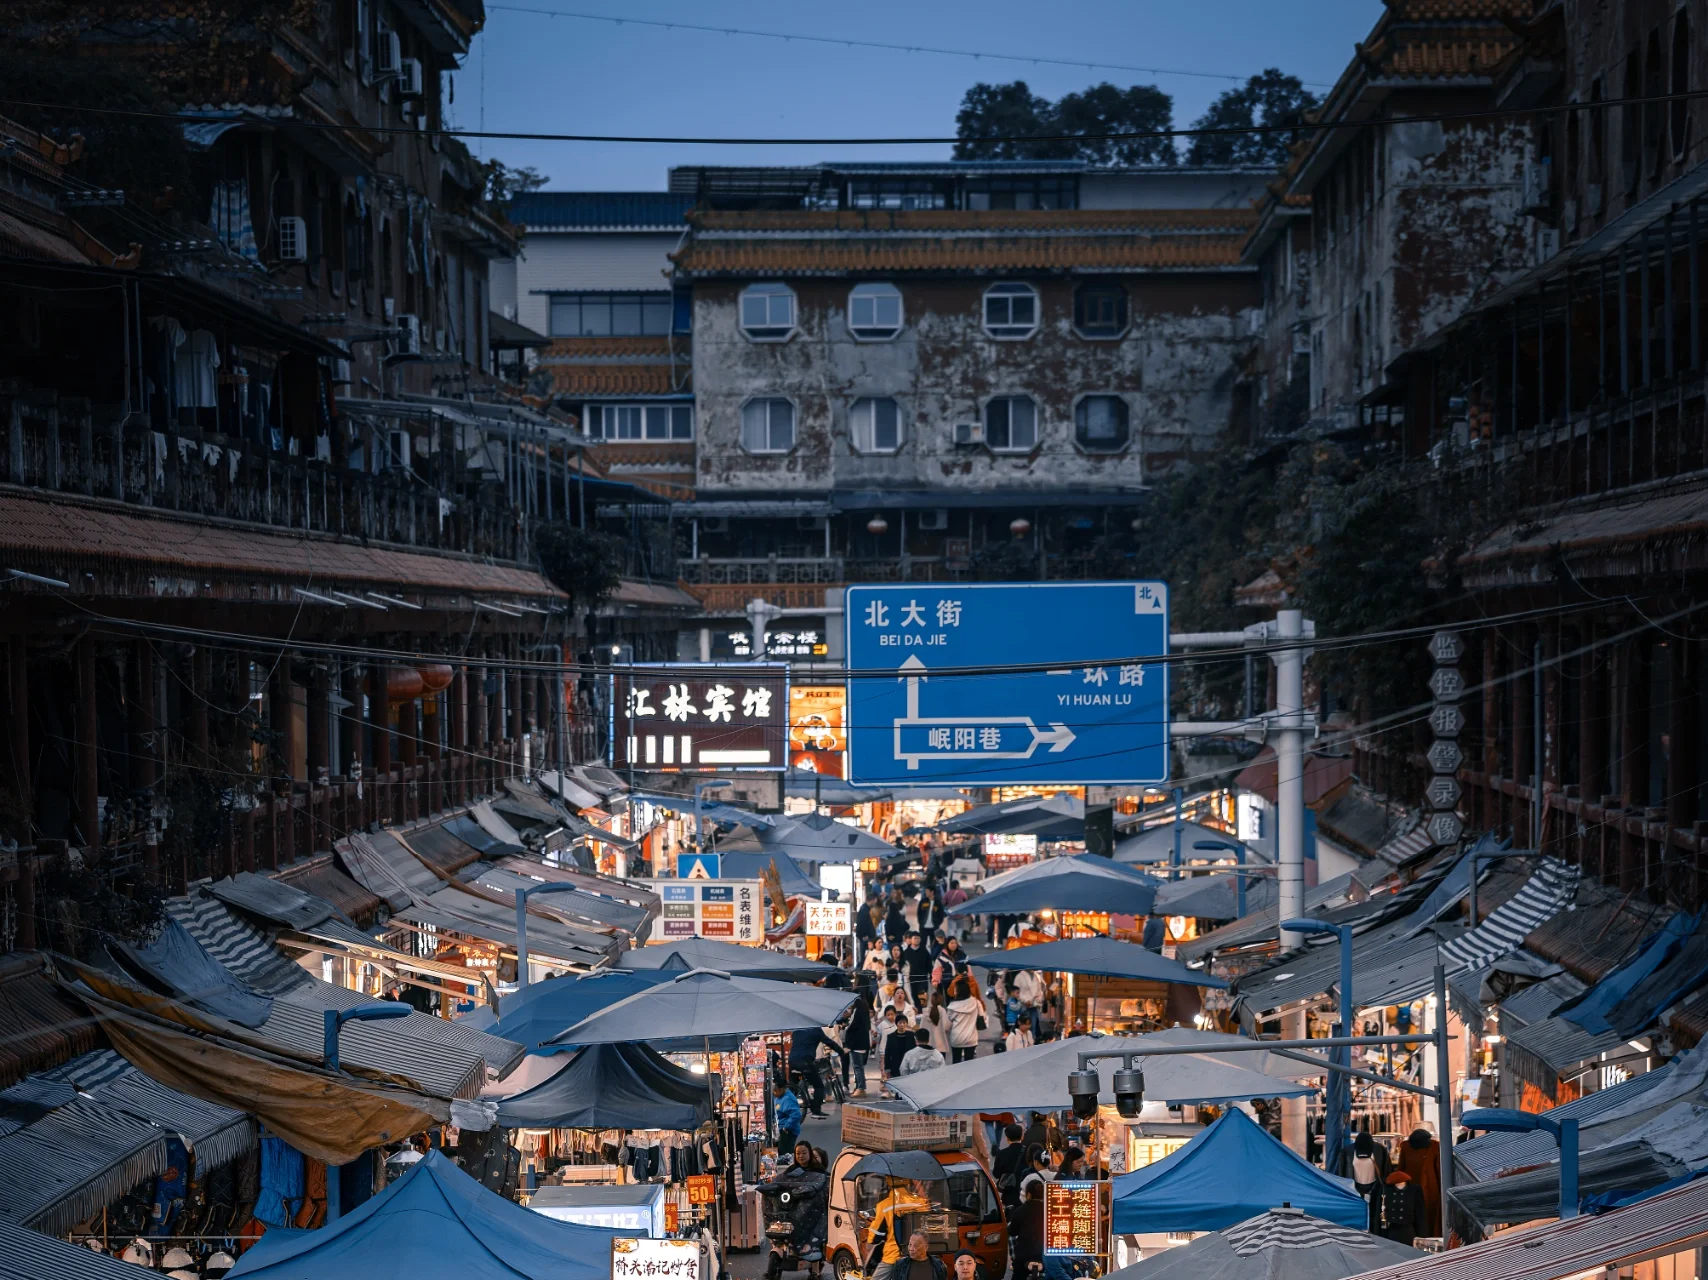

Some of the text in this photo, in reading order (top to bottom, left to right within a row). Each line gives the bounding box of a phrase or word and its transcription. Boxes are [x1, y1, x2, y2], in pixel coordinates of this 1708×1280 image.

[1139, 587, 1151, 600] 北
[864, 599, 962, 628] 北大街
[879, 634, 947, 646] BEI DA JIE
[1057, 693, 1132, 706] YI HUAN LU
[928, 727, 1001, 750] 岷阳巷
[1434, 636, 1457, 840] 监控报警录像
[739, 887, 752, 939] 名表维修
[1051, 1188, 1071, 1250] 手工编串
[1071, 1188, 1092, 1250] 项链脚链
